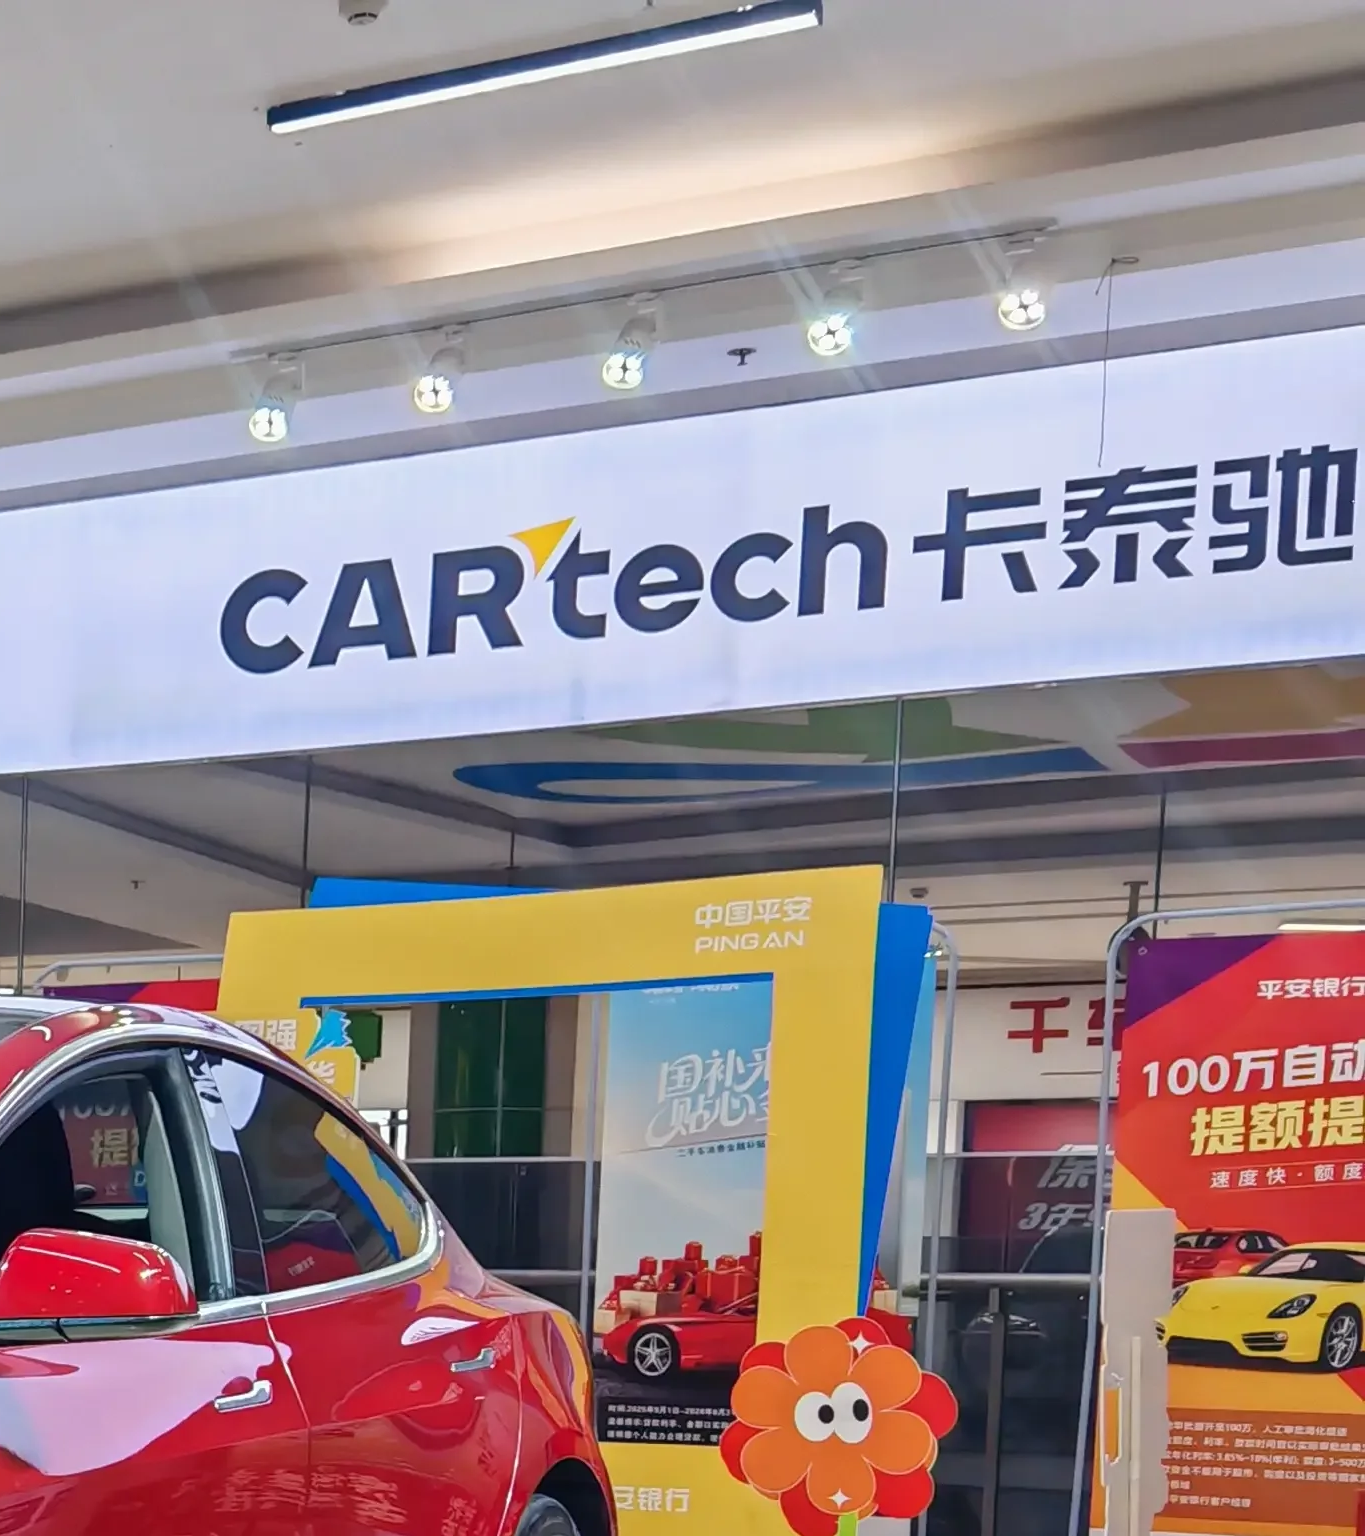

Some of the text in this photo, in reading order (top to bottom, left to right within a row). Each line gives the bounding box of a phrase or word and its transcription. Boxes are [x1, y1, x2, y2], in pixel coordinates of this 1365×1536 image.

[220, 445, 1360, 674] CARtech 卡泰驰
[695, 896, 813, 929] 中国平安
[1257, 976, 1365, 999] 平安银行
[1142, 1039, 1365, 1098] 100万自动
[1190, 1095, 1364, 1156] 提额提
